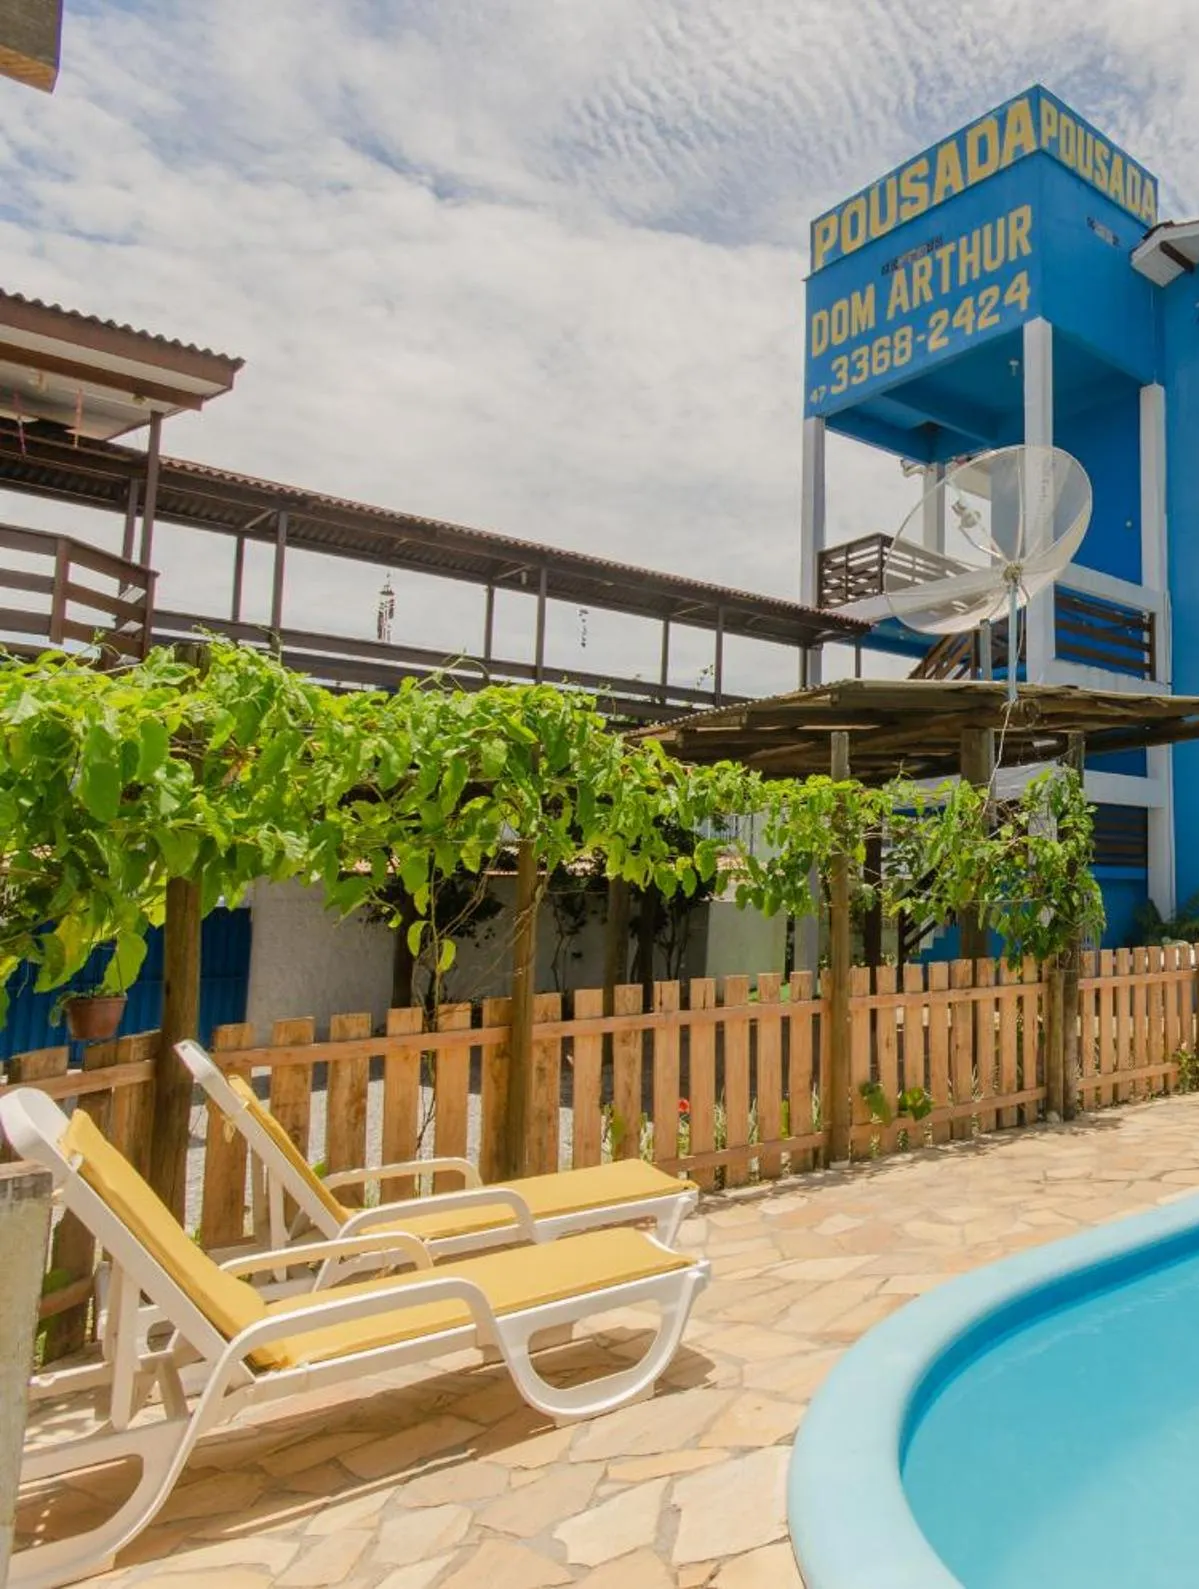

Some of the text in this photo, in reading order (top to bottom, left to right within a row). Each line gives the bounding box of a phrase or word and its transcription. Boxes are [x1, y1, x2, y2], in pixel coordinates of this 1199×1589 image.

[814, 98, 1036, 269] POUSADA
[1040, 98, 1157, 225] POUSADA
[809, 271, 1030, 404] 47 3368-2424
[812, 205, 1032, 357] DOM ARTHUR
